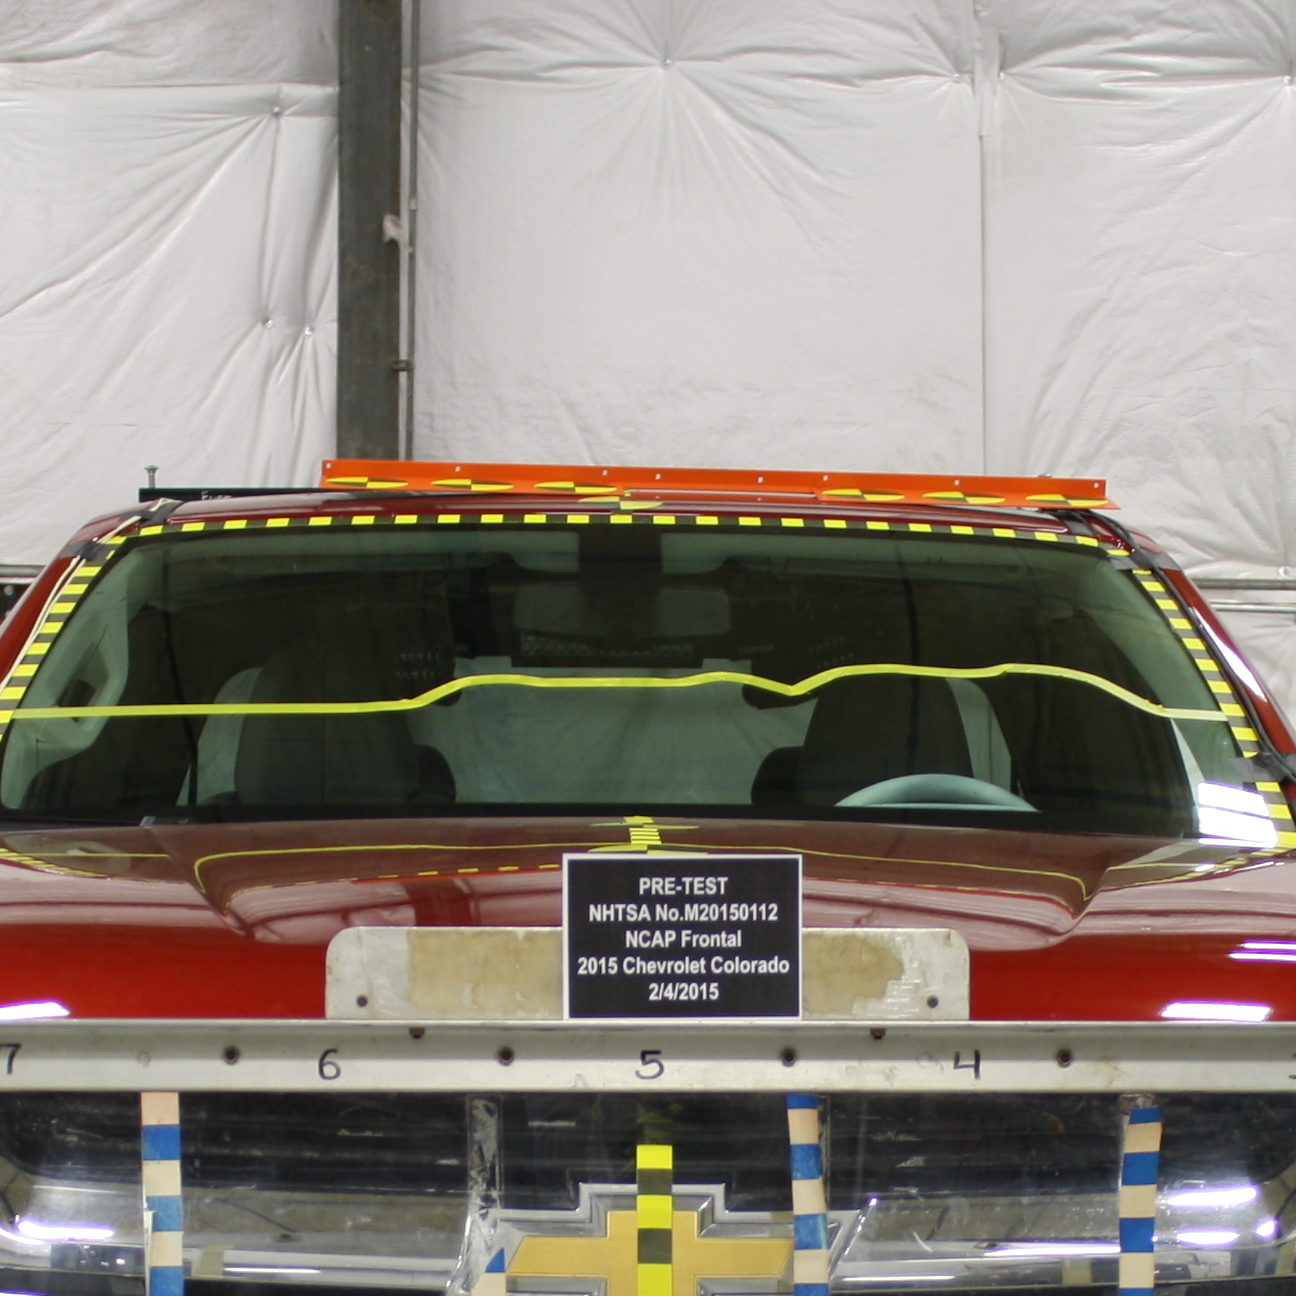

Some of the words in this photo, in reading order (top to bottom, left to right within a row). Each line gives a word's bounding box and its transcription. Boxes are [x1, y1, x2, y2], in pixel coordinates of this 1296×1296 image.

[639, 877, 729, 895] PRE-TEST
[589, 904, 651, 922] NHTSA
[655, 903, 779, 921] No.M20150112
[625, 930, 677, 948] NCAP
[681, 930, 743, 948] Frontal
[577, 957, 618, 975] 2015
[622, 957, 707, 974] Chevrolet
[710, 956, 790, 974] Colorado
[648, 983, 720, 1001] 2/4/2015
[317, 1048, 342, 1080] 6
[635, 1049, 665, 1080] 5
[952, 1049, 982, 1080] 4
